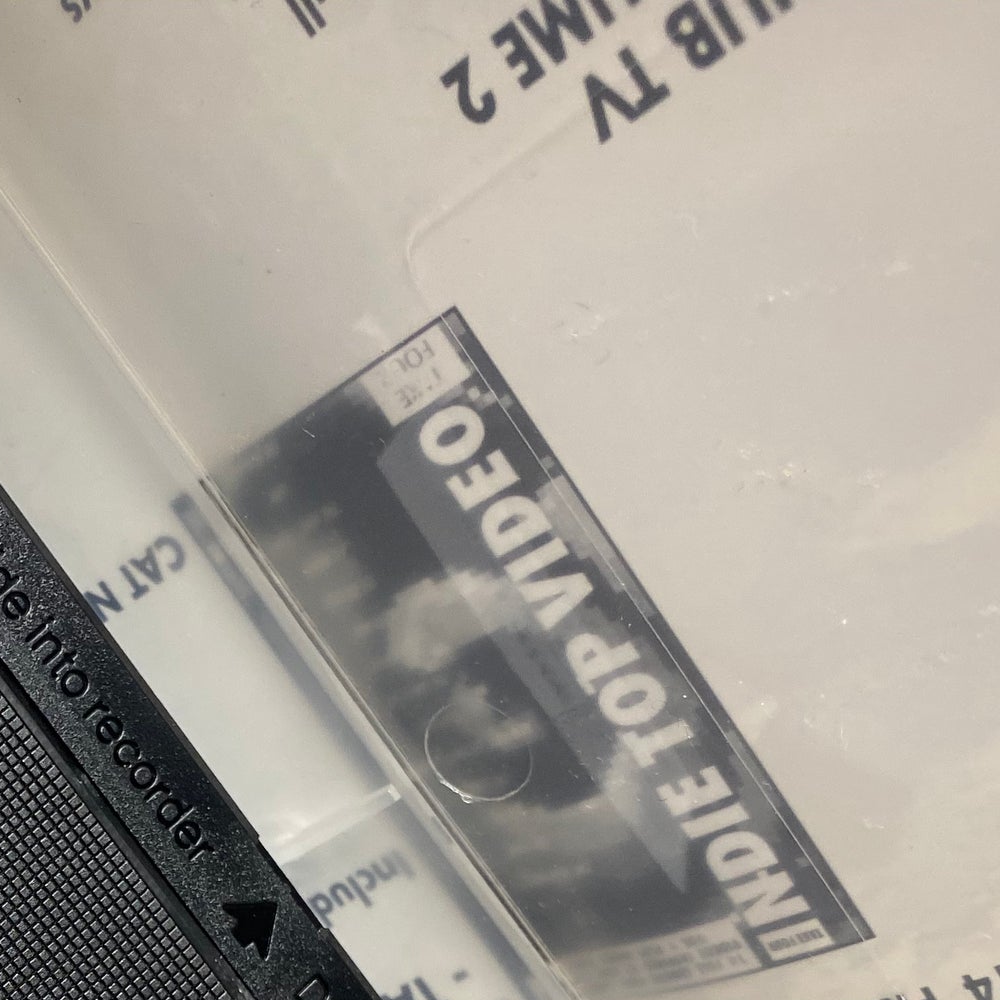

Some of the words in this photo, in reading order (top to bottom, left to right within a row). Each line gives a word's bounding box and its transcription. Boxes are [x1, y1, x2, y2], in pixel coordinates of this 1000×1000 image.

[439, 54, 497, 125] 2
[583, 46, 671, 145] TV
[119, 535, 185, 600] CAT
[419, 405, 594, 630] VIDEO
[24, 618, 91, 700] into
[82, 699, 214, 863] recorder
[565, 632, 696, 768] TOP
